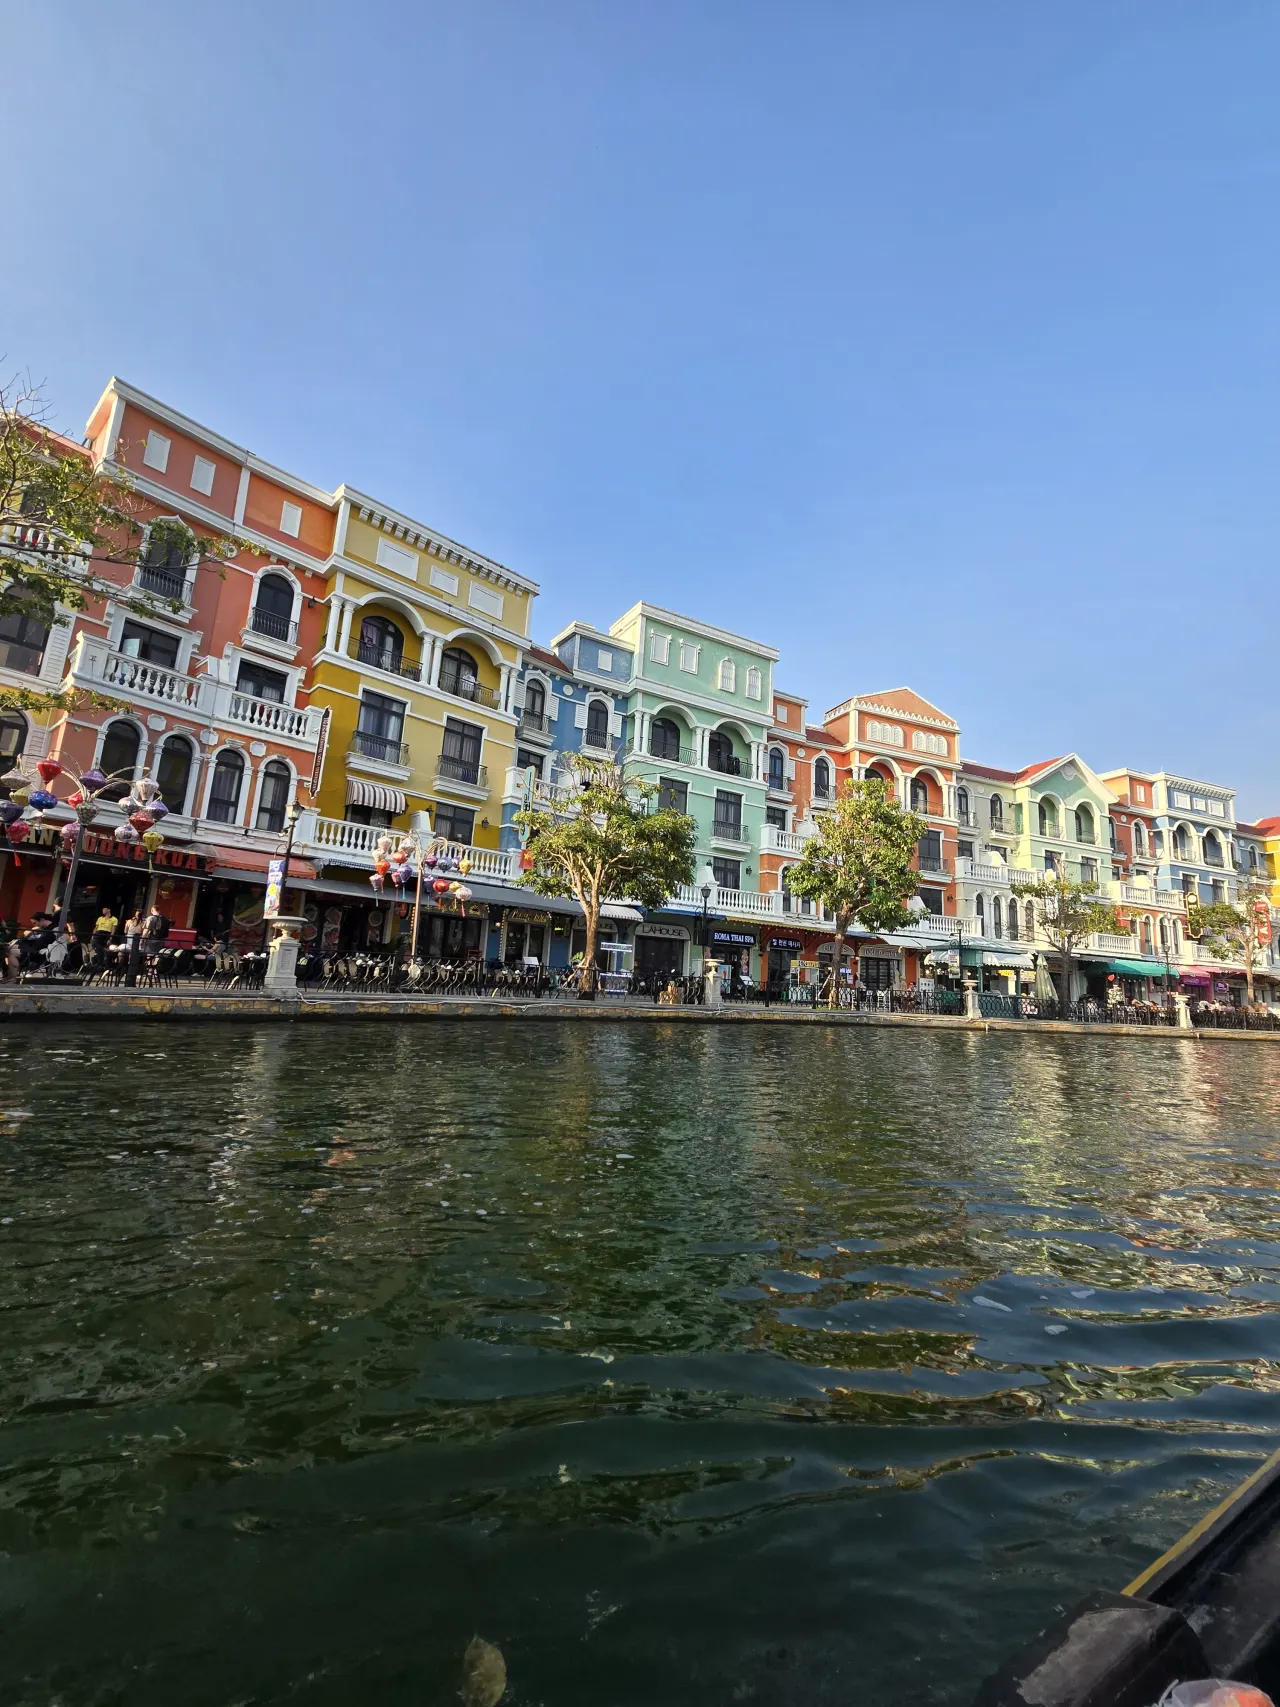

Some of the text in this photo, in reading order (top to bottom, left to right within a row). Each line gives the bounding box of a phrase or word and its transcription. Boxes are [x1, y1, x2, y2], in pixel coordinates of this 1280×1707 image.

[154, 848, 198, 870] KUA
[204, 857, 217, 873] 2
[714, 932, 755, 944] ROMA THAI SPA
